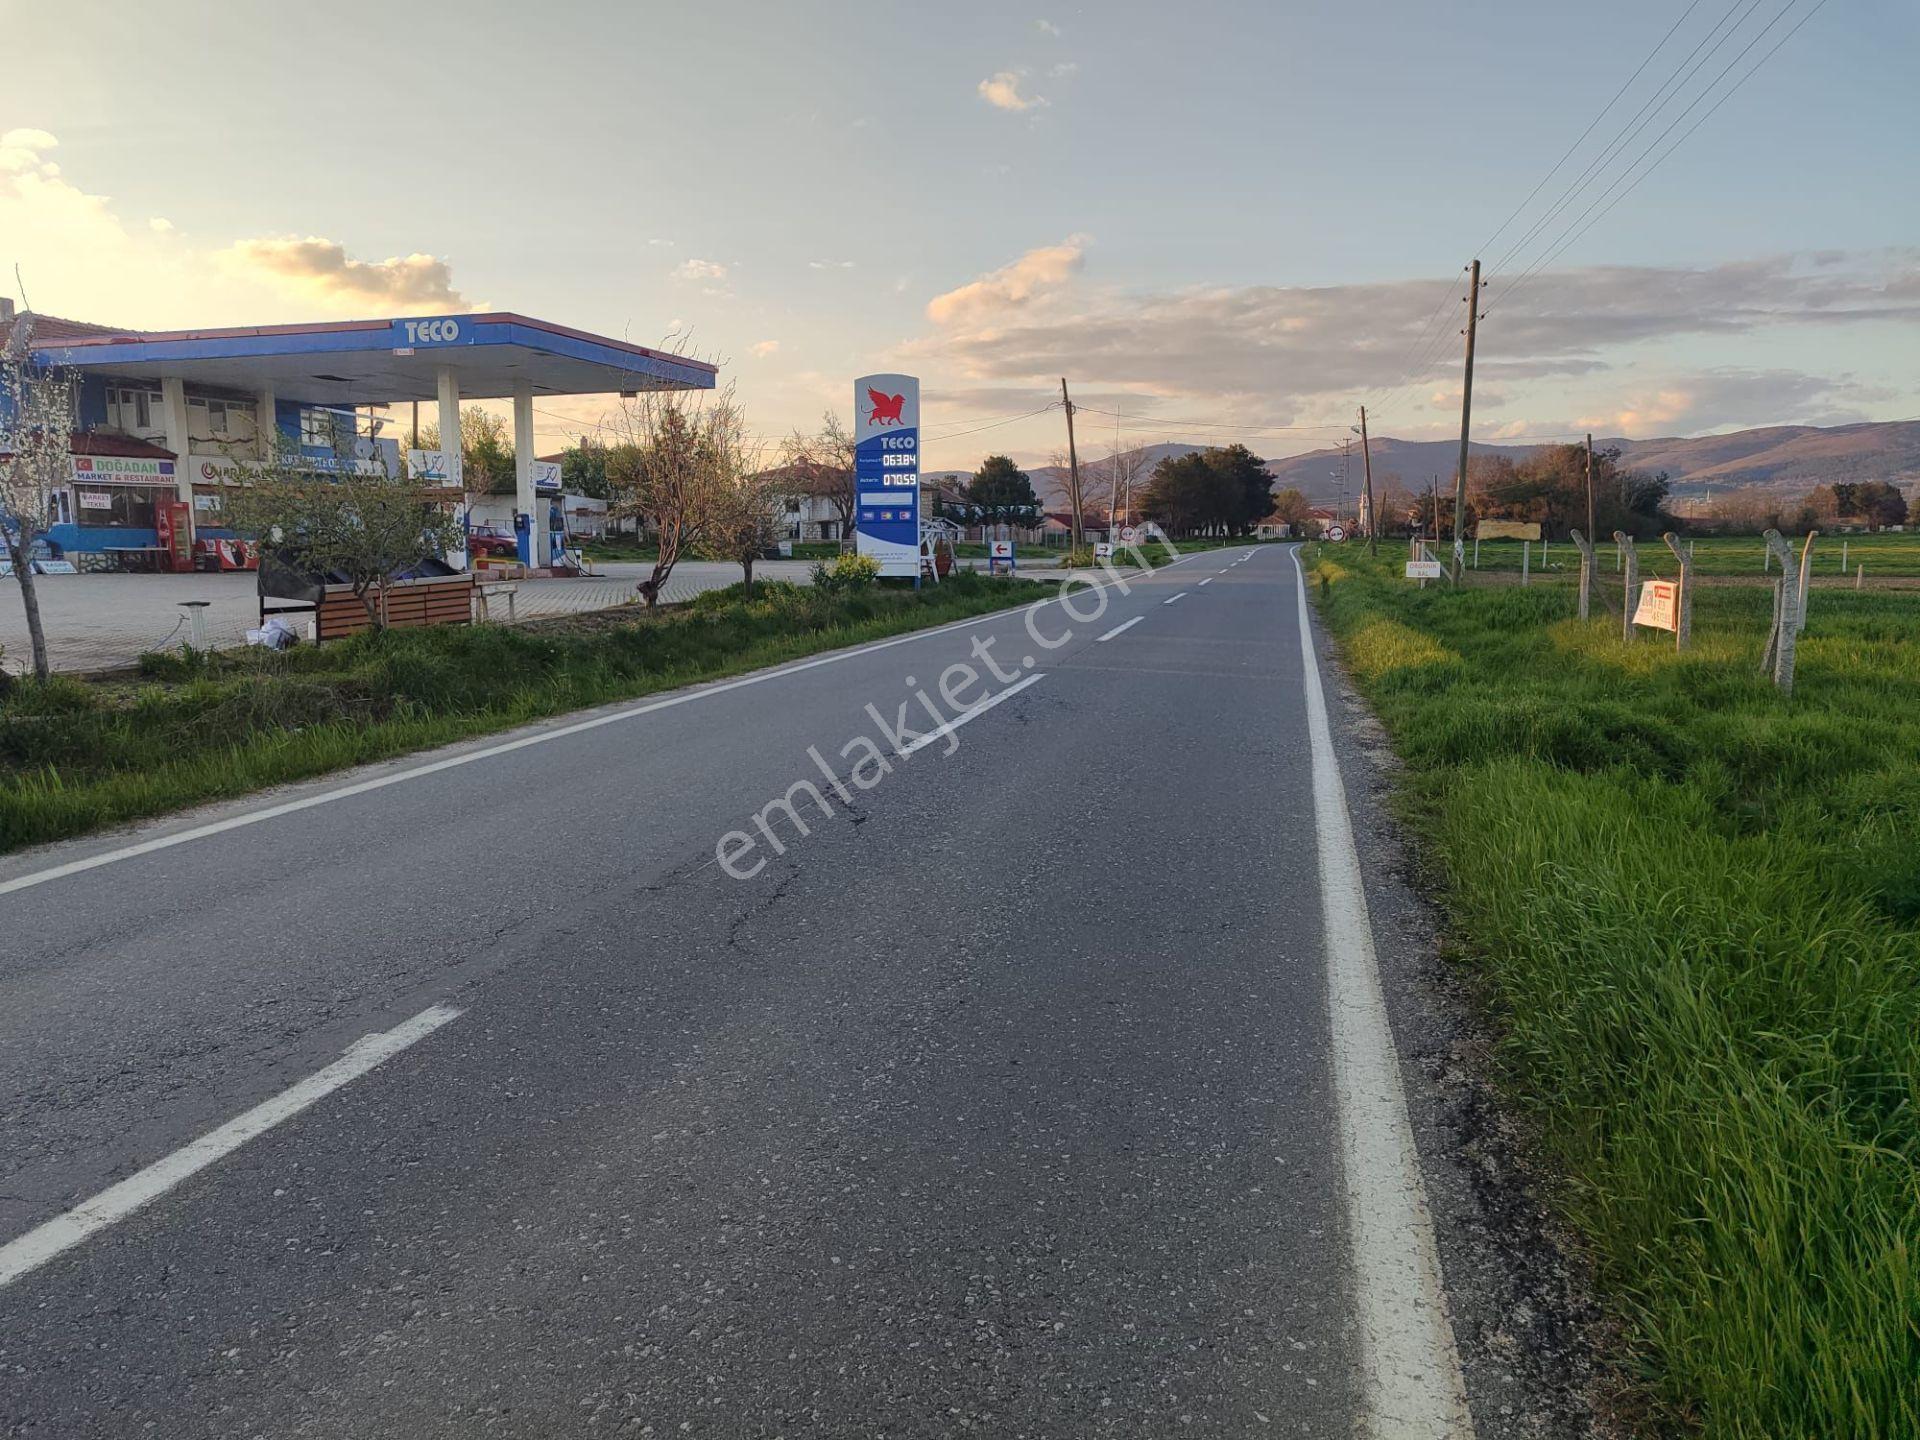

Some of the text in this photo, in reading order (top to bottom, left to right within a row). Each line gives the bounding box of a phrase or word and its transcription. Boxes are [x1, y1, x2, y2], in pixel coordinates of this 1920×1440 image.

[405, 319, 459, 343] TECO
[881, 436, 915, 449] TECO
[96, 459, 157, 473] DOĞADAN
[77, 473, 112, 481] MARKET
[124, 475, 176, 483] RESTAURANT
